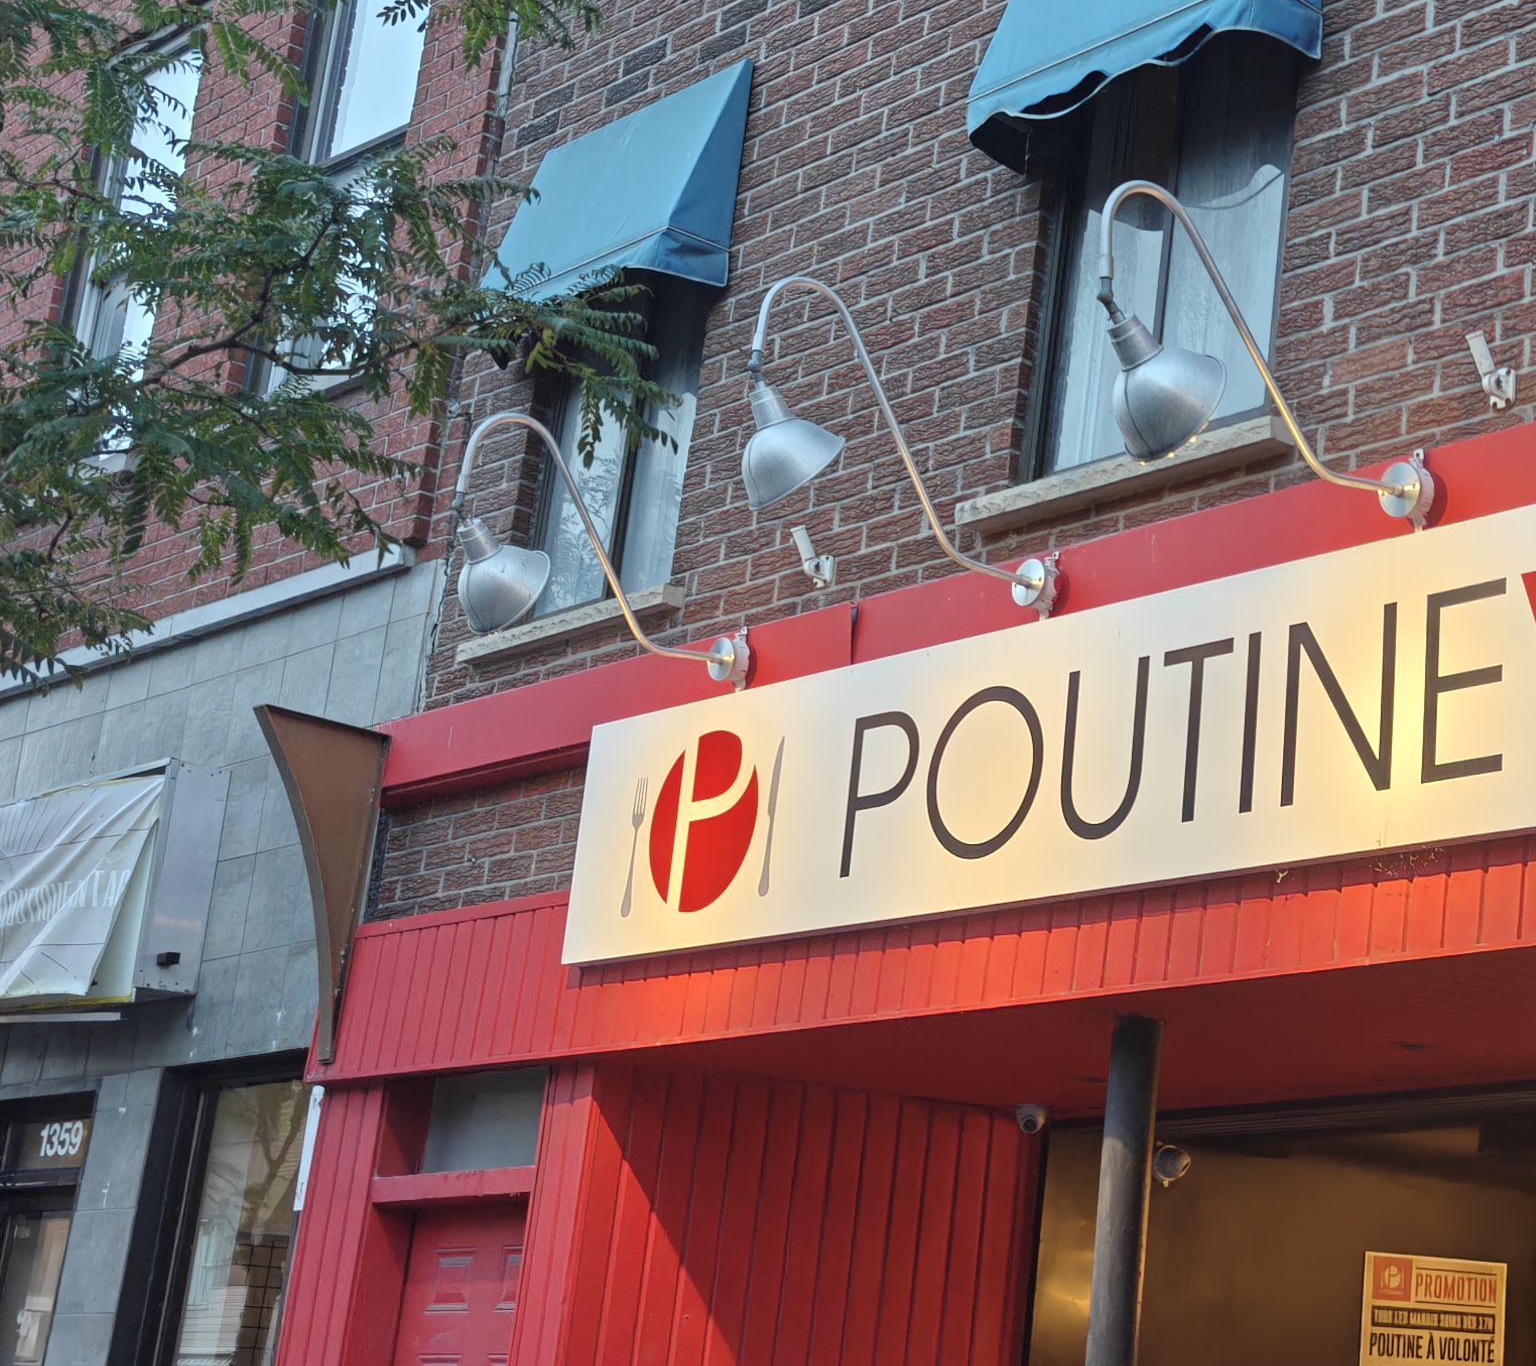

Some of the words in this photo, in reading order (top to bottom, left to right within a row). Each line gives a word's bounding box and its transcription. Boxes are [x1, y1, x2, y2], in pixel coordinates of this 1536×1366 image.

[40, 1121, 83, 1156] 1359
[1415, 1273, 1497, 1304] PROMOTION
[1369, 1332, 1423, 1359] POUTINE
[1426, 1331, 1435, 1360] À
[1439, 1335, 1495, 1363] VOLONTÉ
